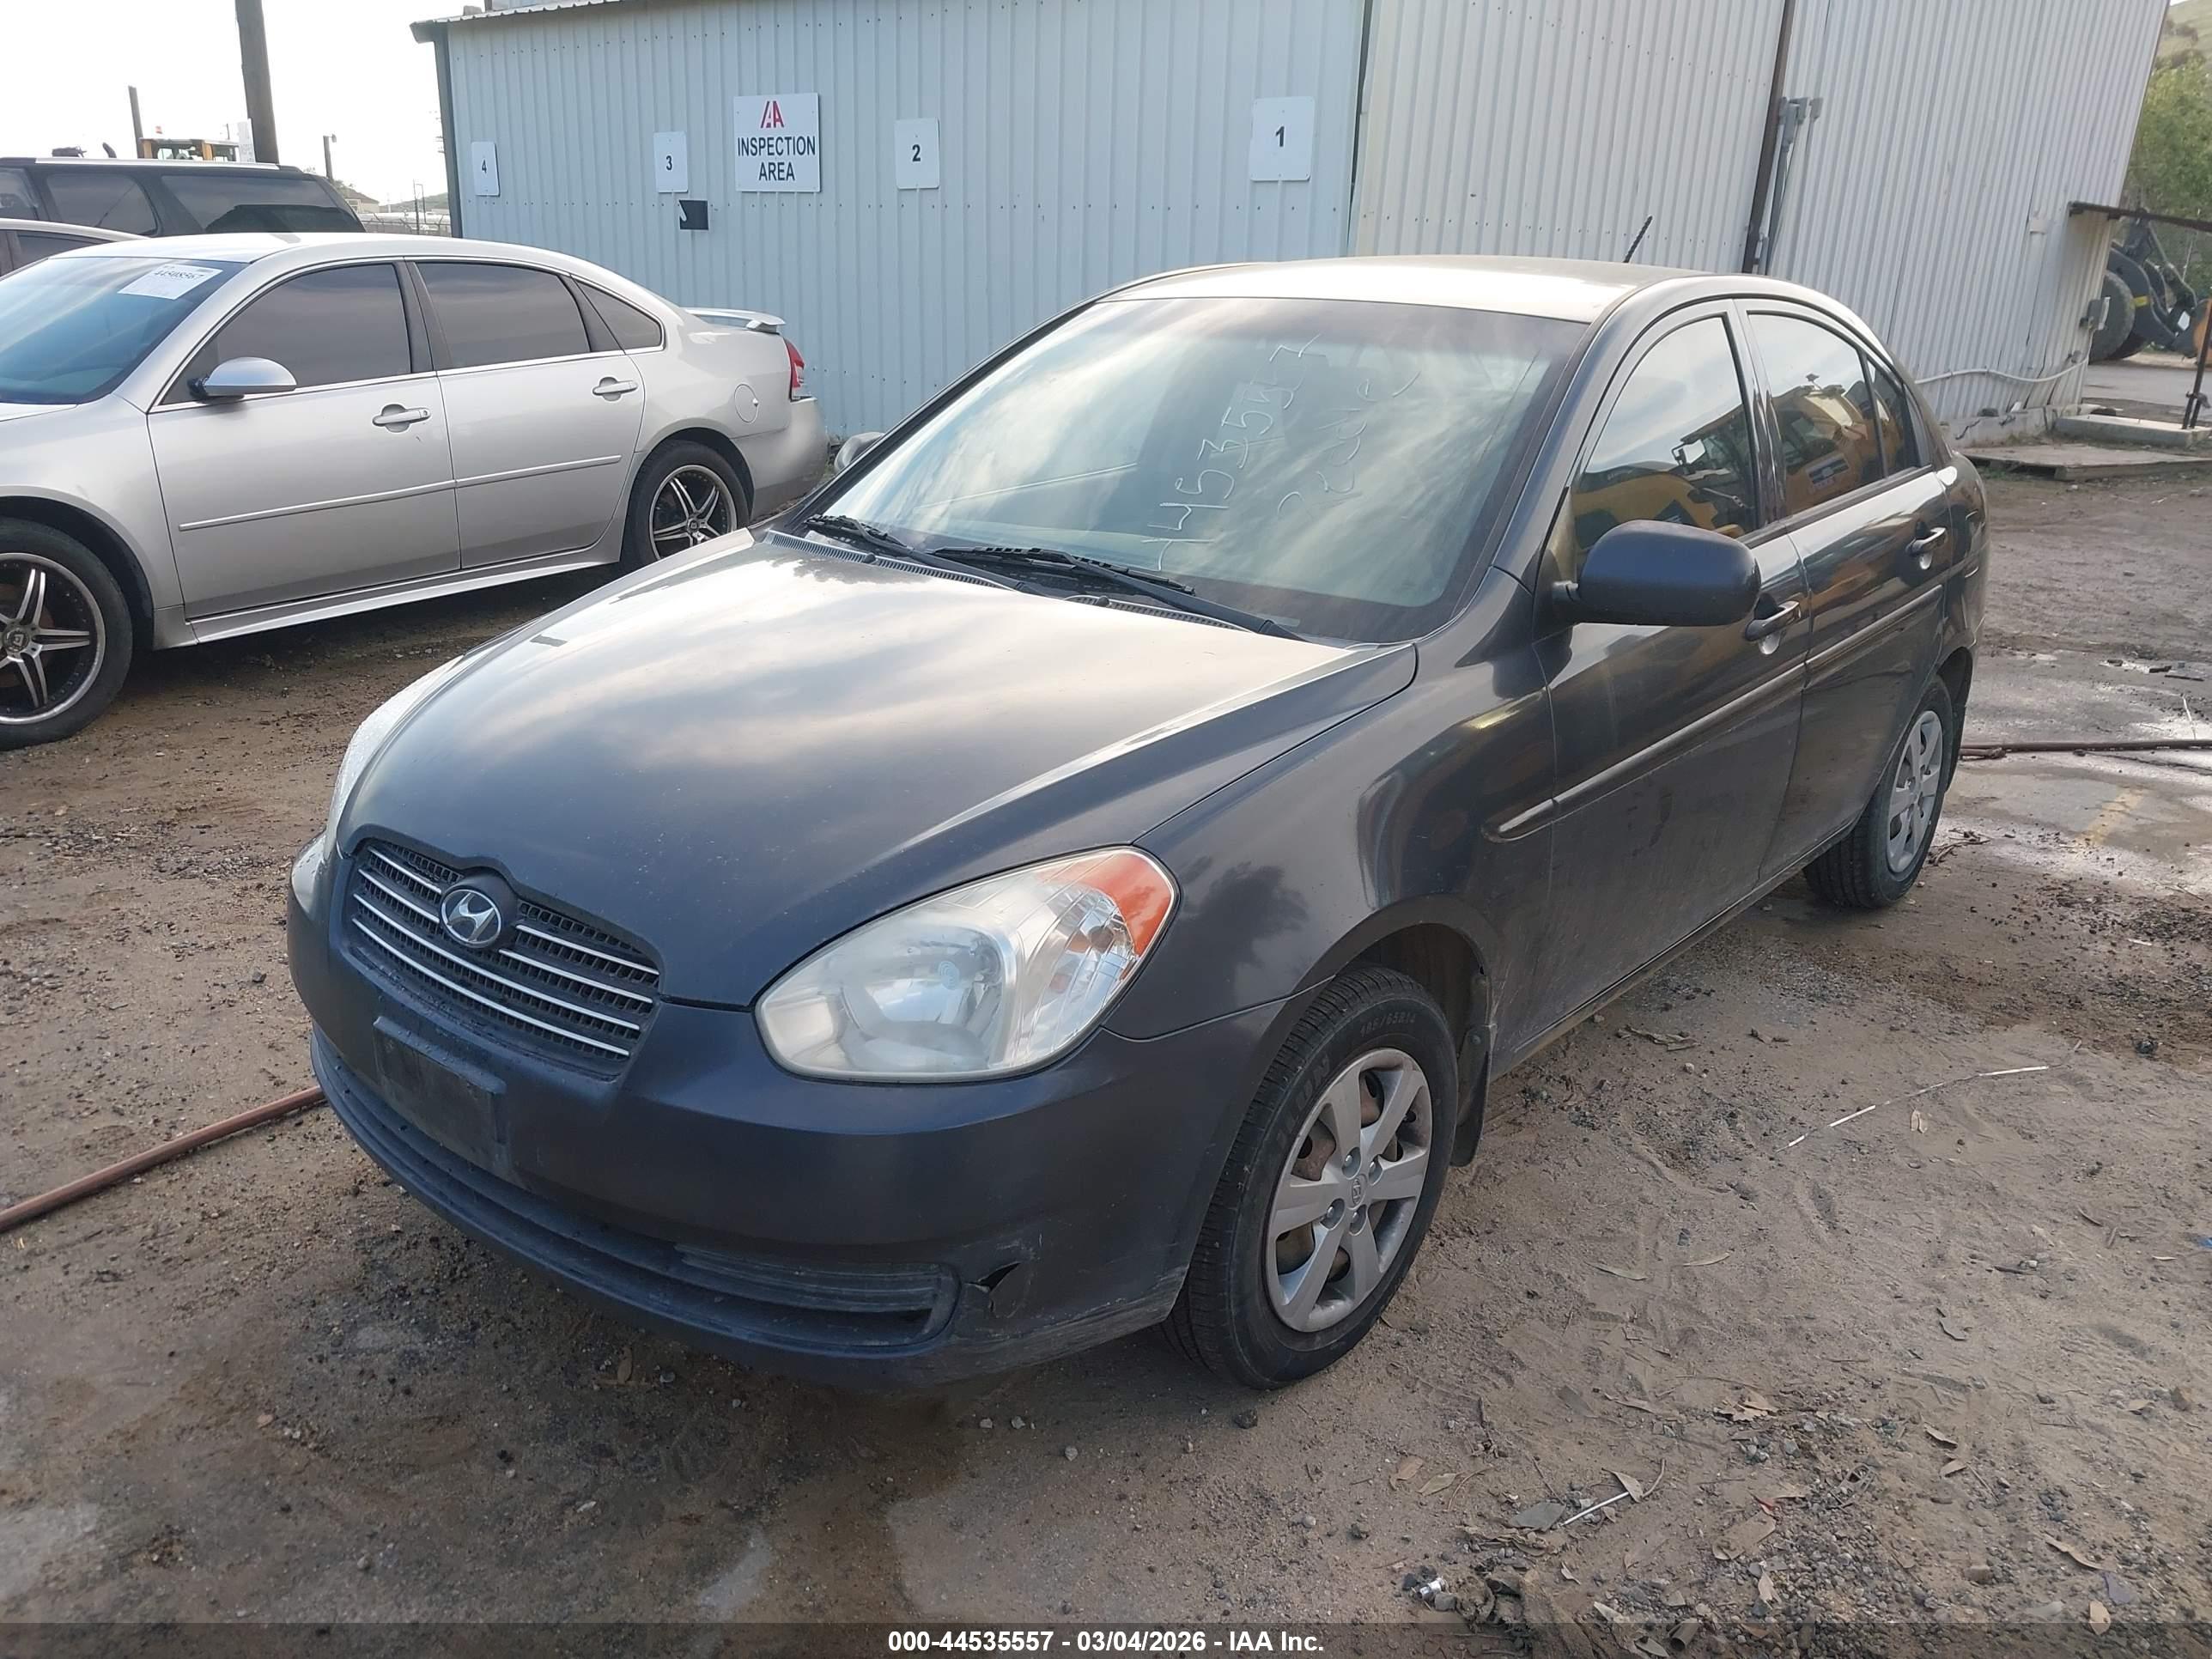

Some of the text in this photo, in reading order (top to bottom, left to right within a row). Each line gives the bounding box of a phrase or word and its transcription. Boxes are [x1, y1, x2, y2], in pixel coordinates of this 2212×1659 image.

[738, 136, 815, 155] INSPECTION
[1275, 126, 1285, 147] 1
[912, 144, 921, 161] 2
[482, 159, 487, 173] 4
[665, 155, 672, 170] 3
[758, 161, 795, 180] AREA
